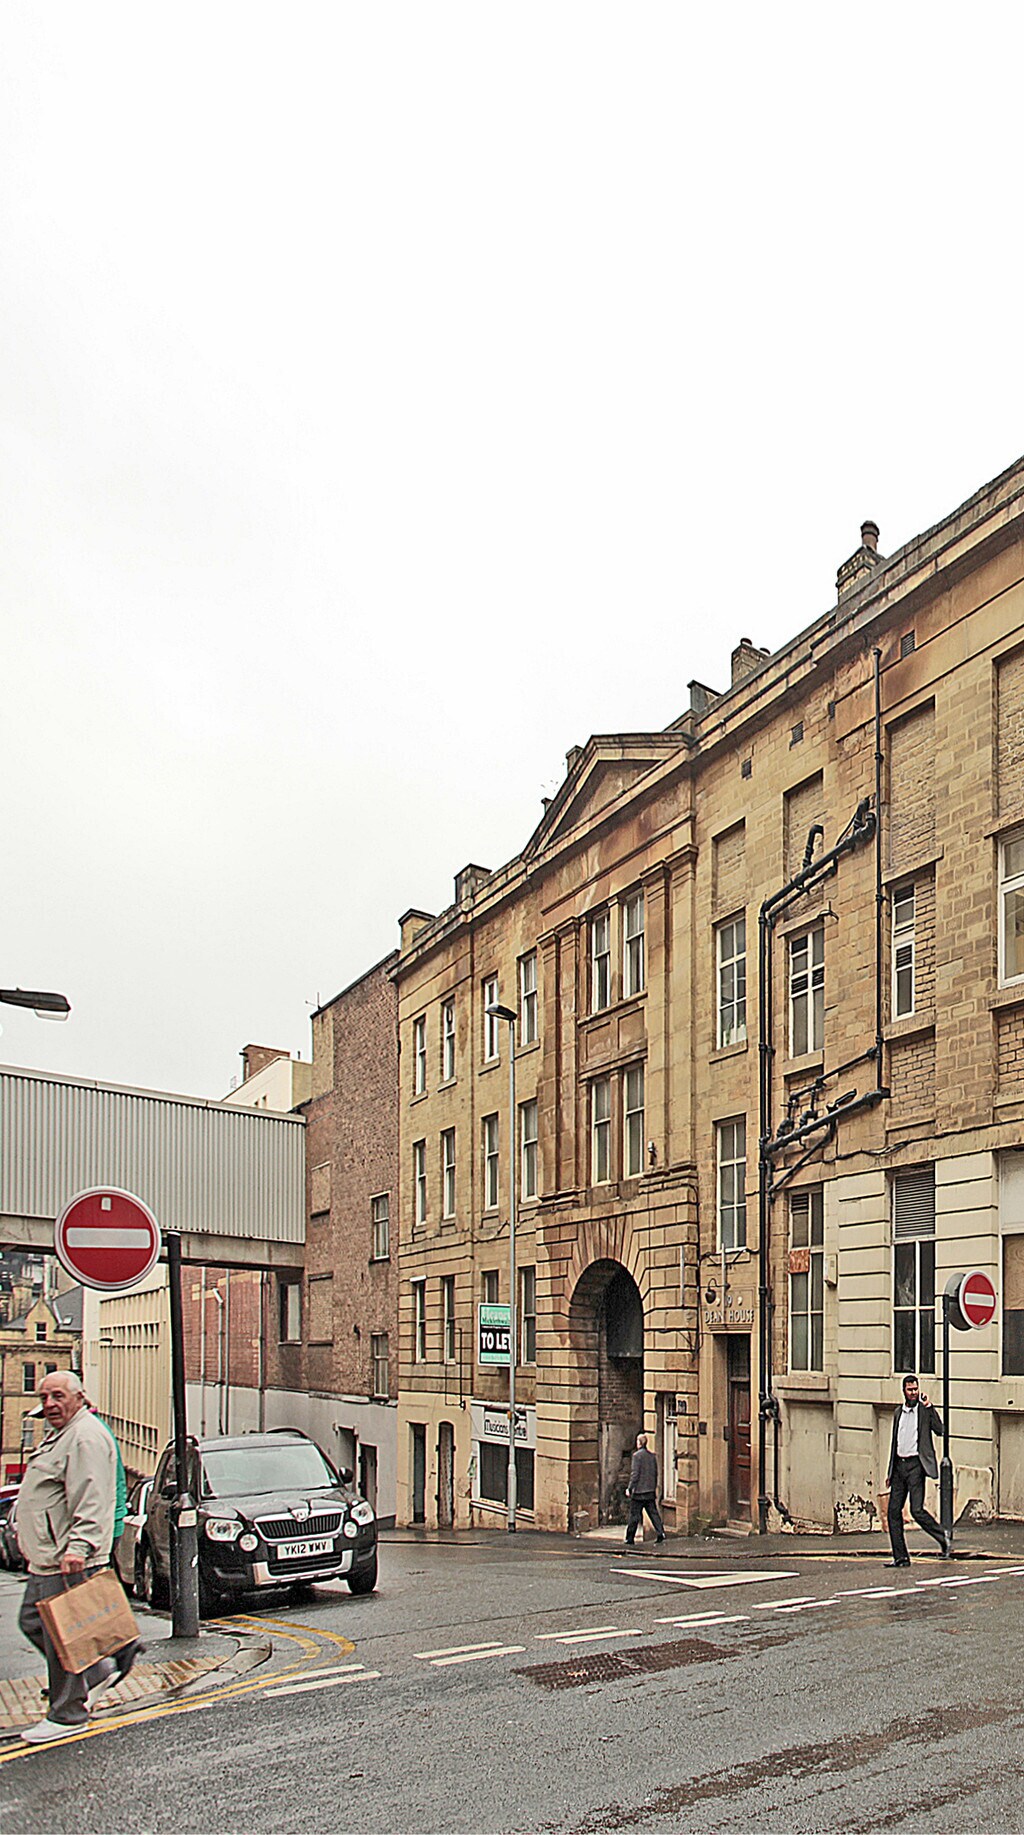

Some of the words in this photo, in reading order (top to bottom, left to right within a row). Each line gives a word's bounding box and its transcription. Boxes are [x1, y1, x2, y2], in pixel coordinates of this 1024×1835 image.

[705, 1311, 724, 1323] DEAN
[729, 1310, 754, 1323] HOUSE
[481, 1333, 494, 1349] TO
[285, 1544, 306, 1555] YK12
